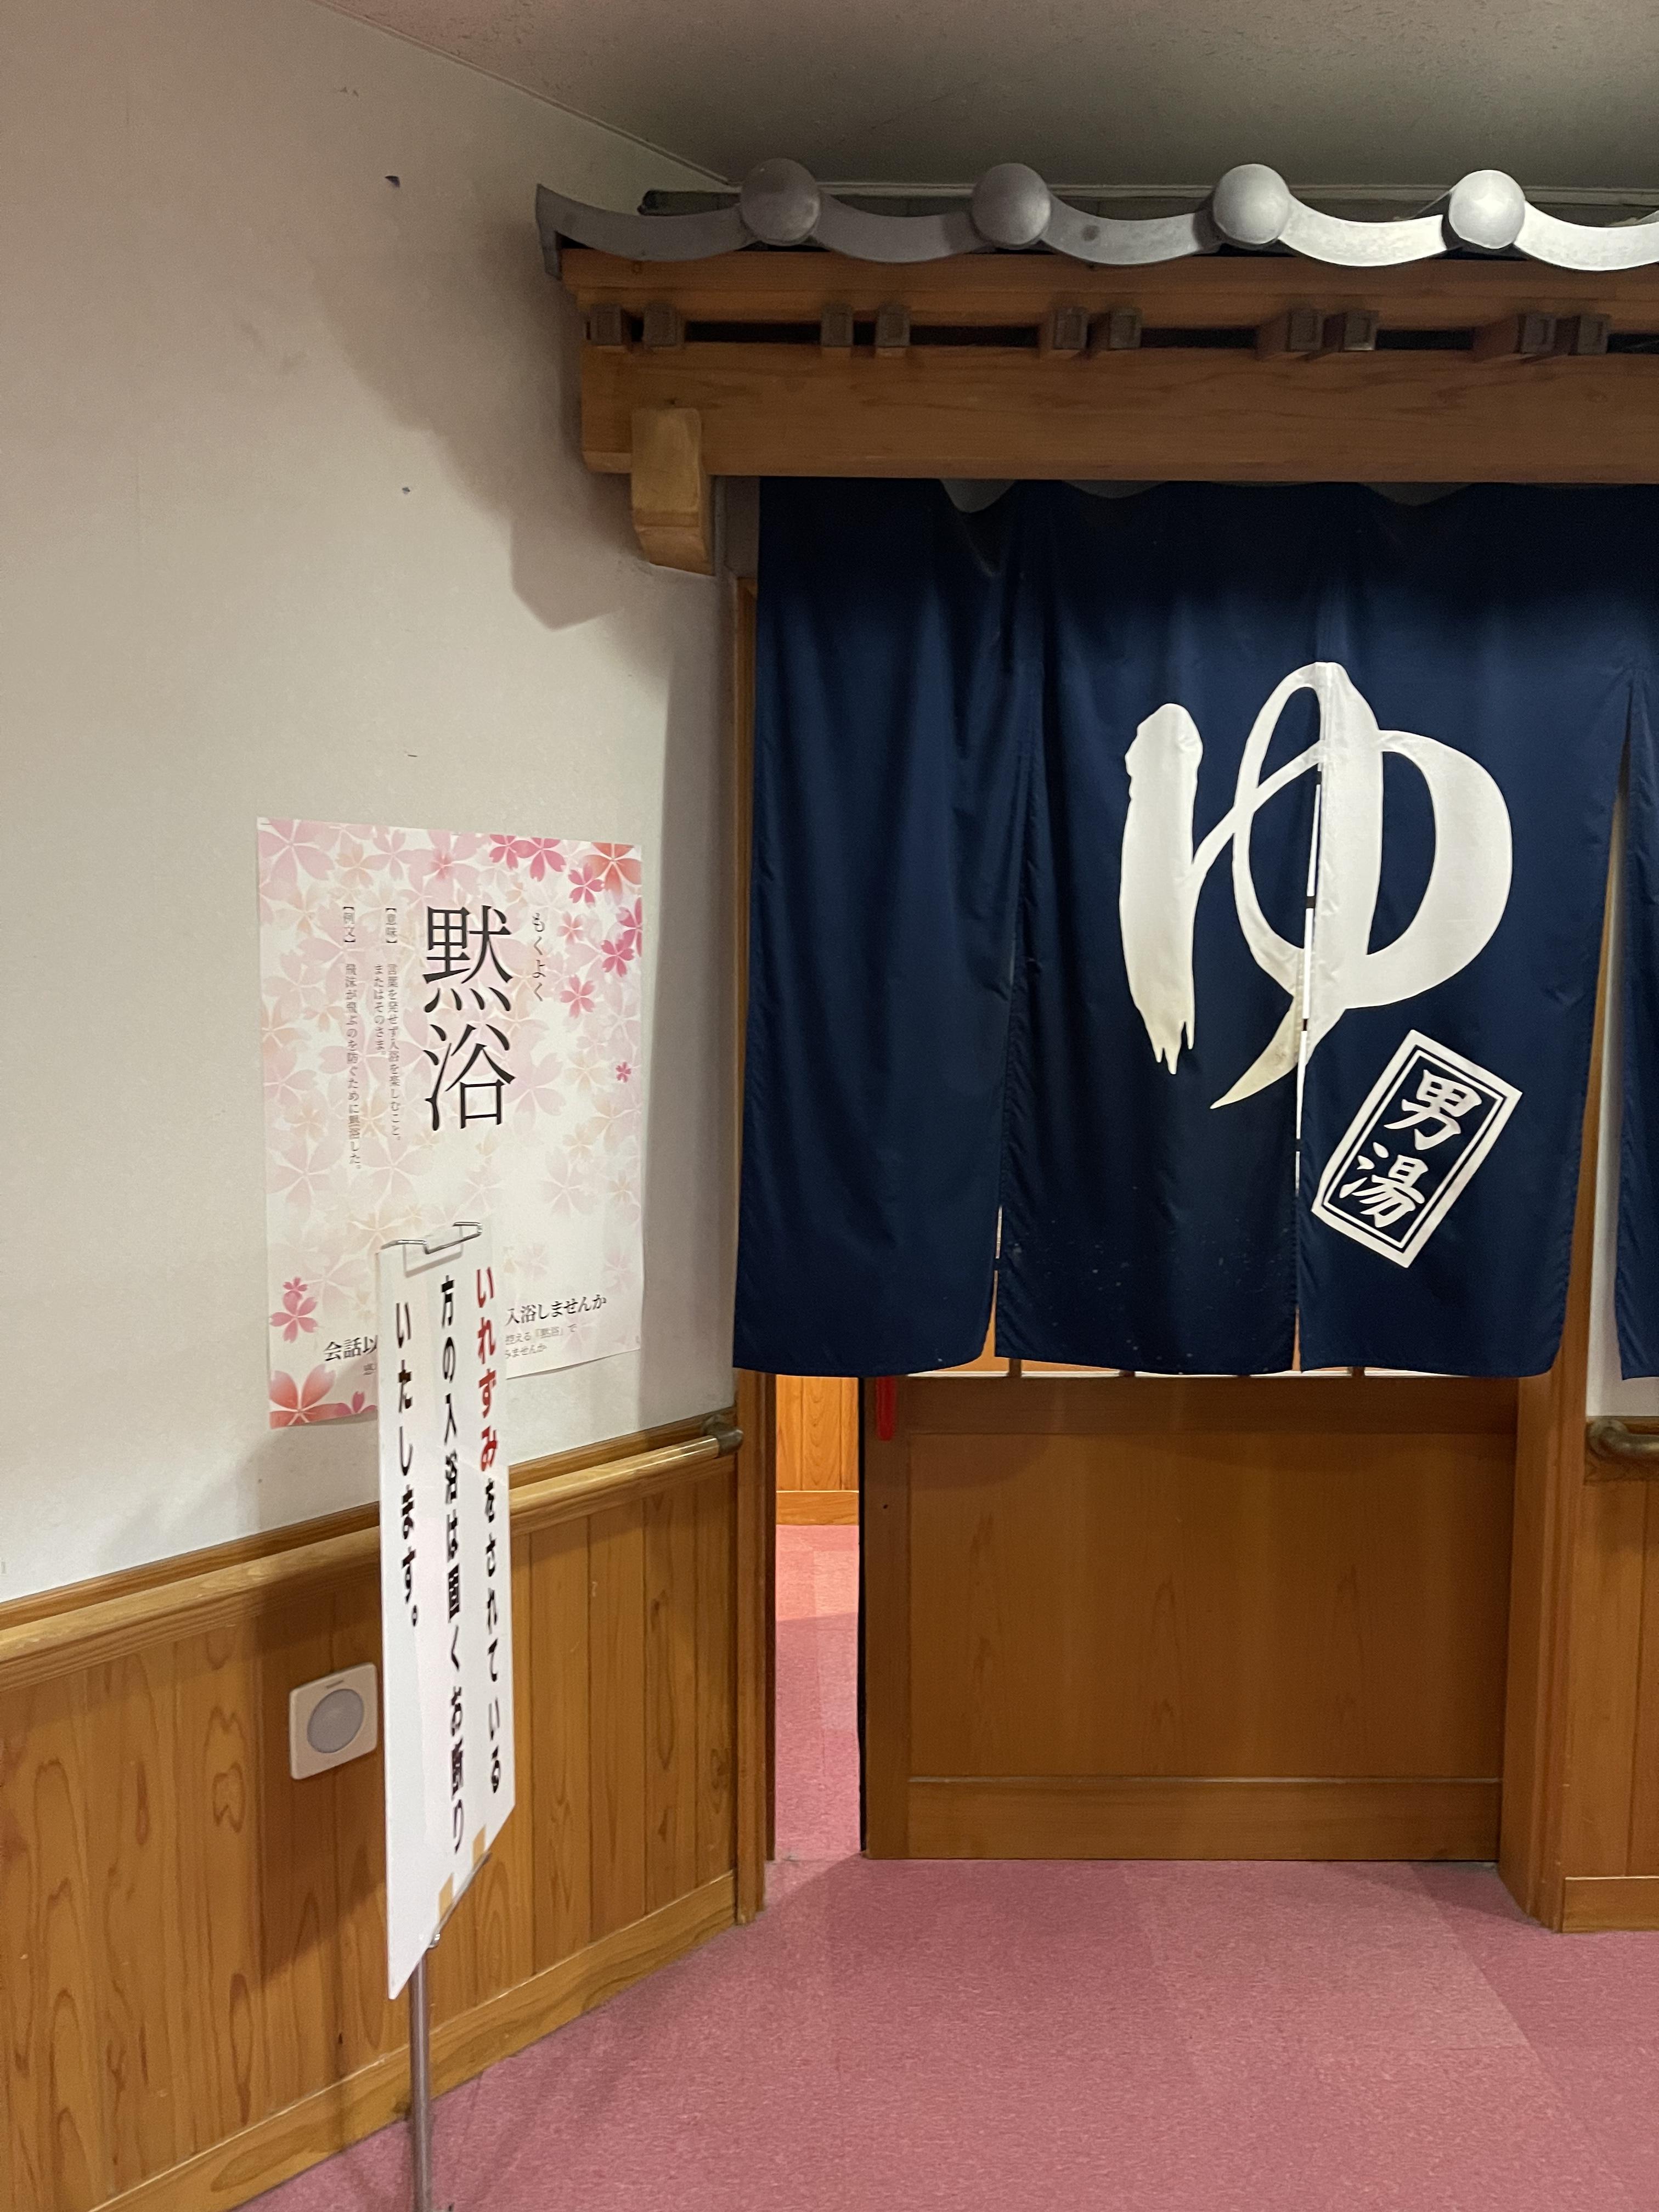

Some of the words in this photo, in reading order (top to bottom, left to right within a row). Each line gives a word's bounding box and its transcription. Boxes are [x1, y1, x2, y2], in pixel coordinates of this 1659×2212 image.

[422, 905, 517, 1131] 黙浴
[532, 912, 546, 1002] もくよく
[1119, 662, 1513, 1109] ゆ
[1338, 1069, 1482, 1228] 男湯
[396, 1302, 417, 1627] いたします。
[441, 1274, 464, 1854] 方の入浴は固くお断り
[476, 1266, 500, 1794] いれずみをされている
